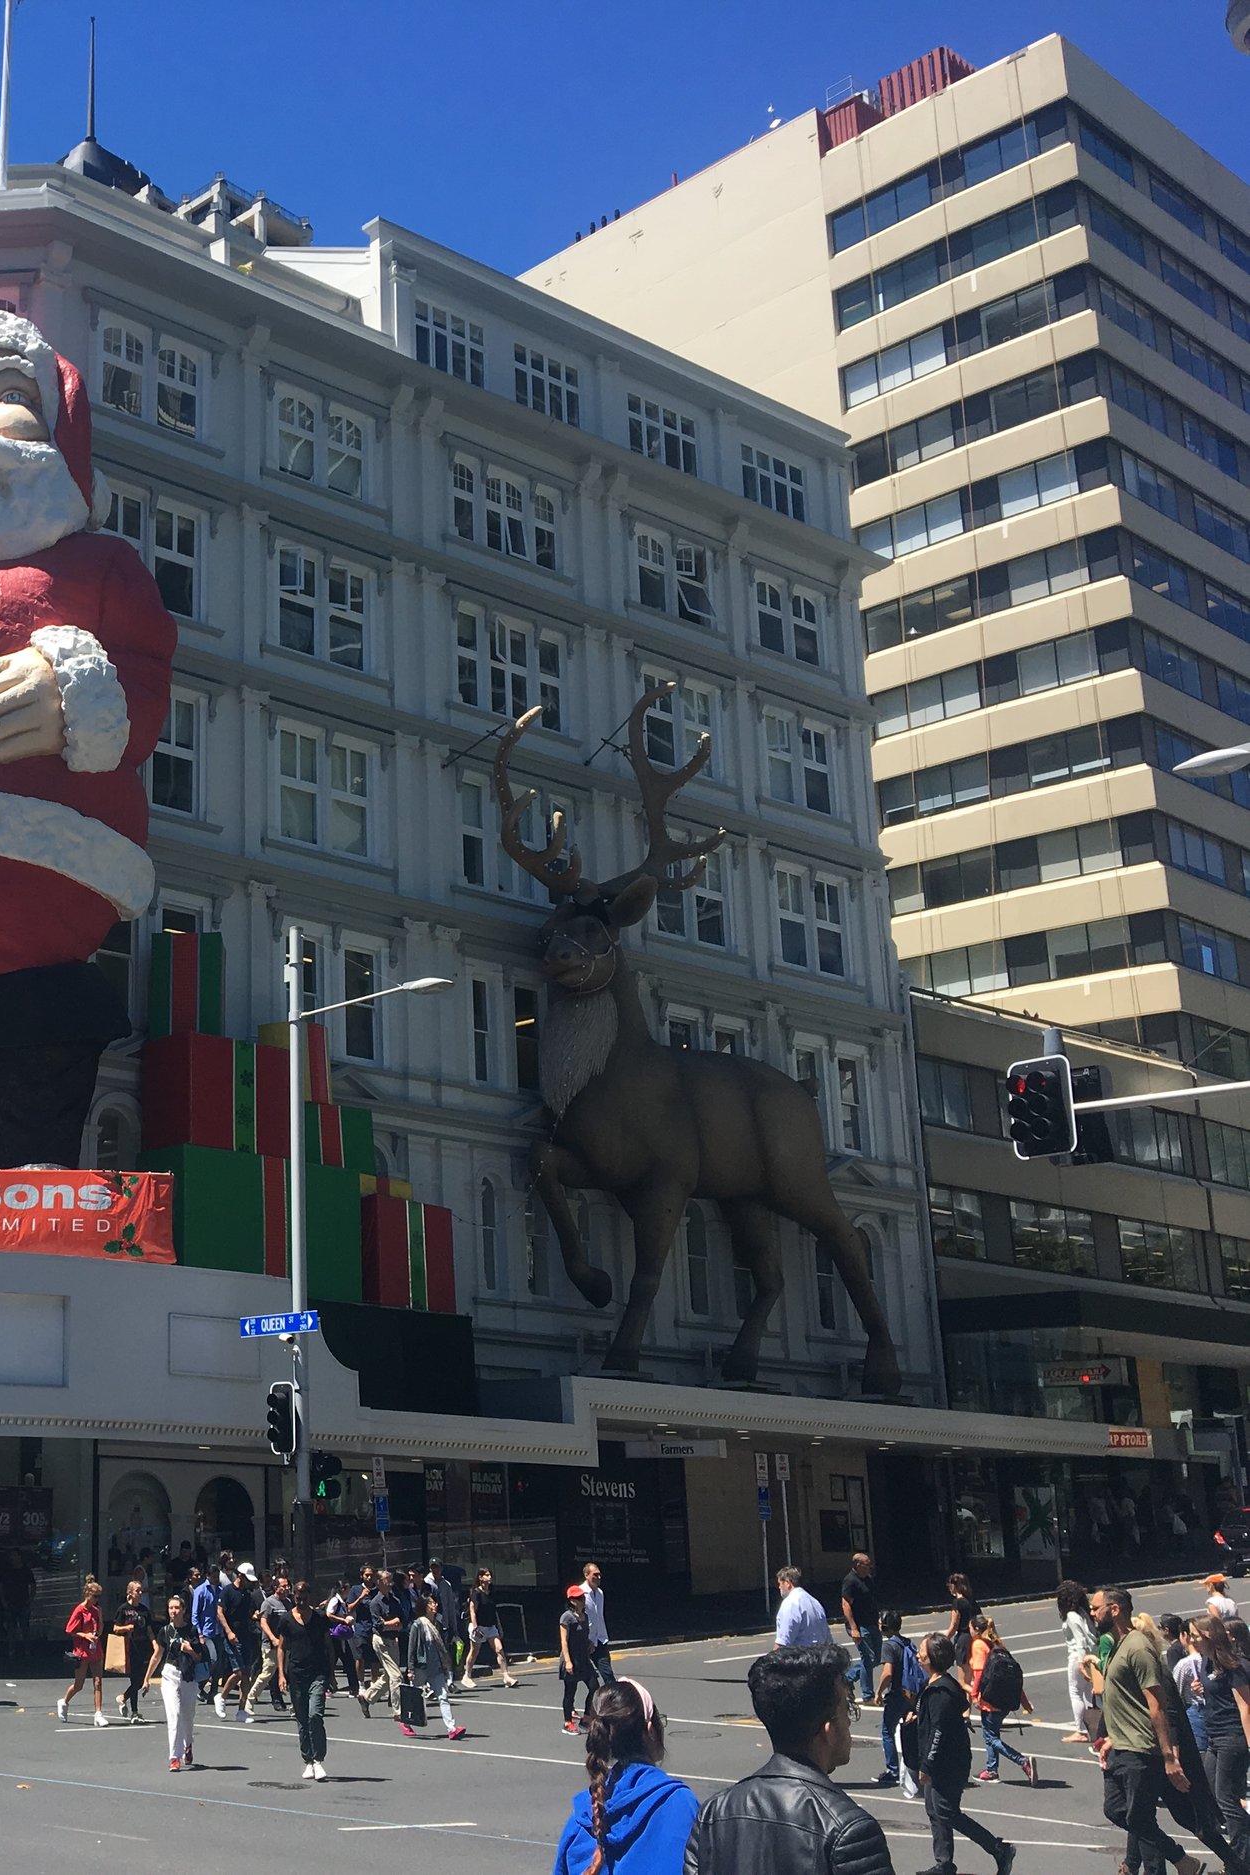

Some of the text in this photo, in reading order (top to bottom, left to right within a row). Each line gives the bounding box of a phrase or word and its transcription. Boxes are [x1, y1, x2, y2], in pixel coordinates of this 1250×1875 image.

[261, 1317, 286, 1332] QUEEN
[1120, 1434, 1148, 1447] STORE
[660, 1443, 695, 1455] Farmers
[471, 1472, 502, 1484] BLACK
[425, 1480, 446, 1491] DAY
[471, 1483, 503, 1495] FRIDAY
[580, 1473, 637, 1499] Stevens
